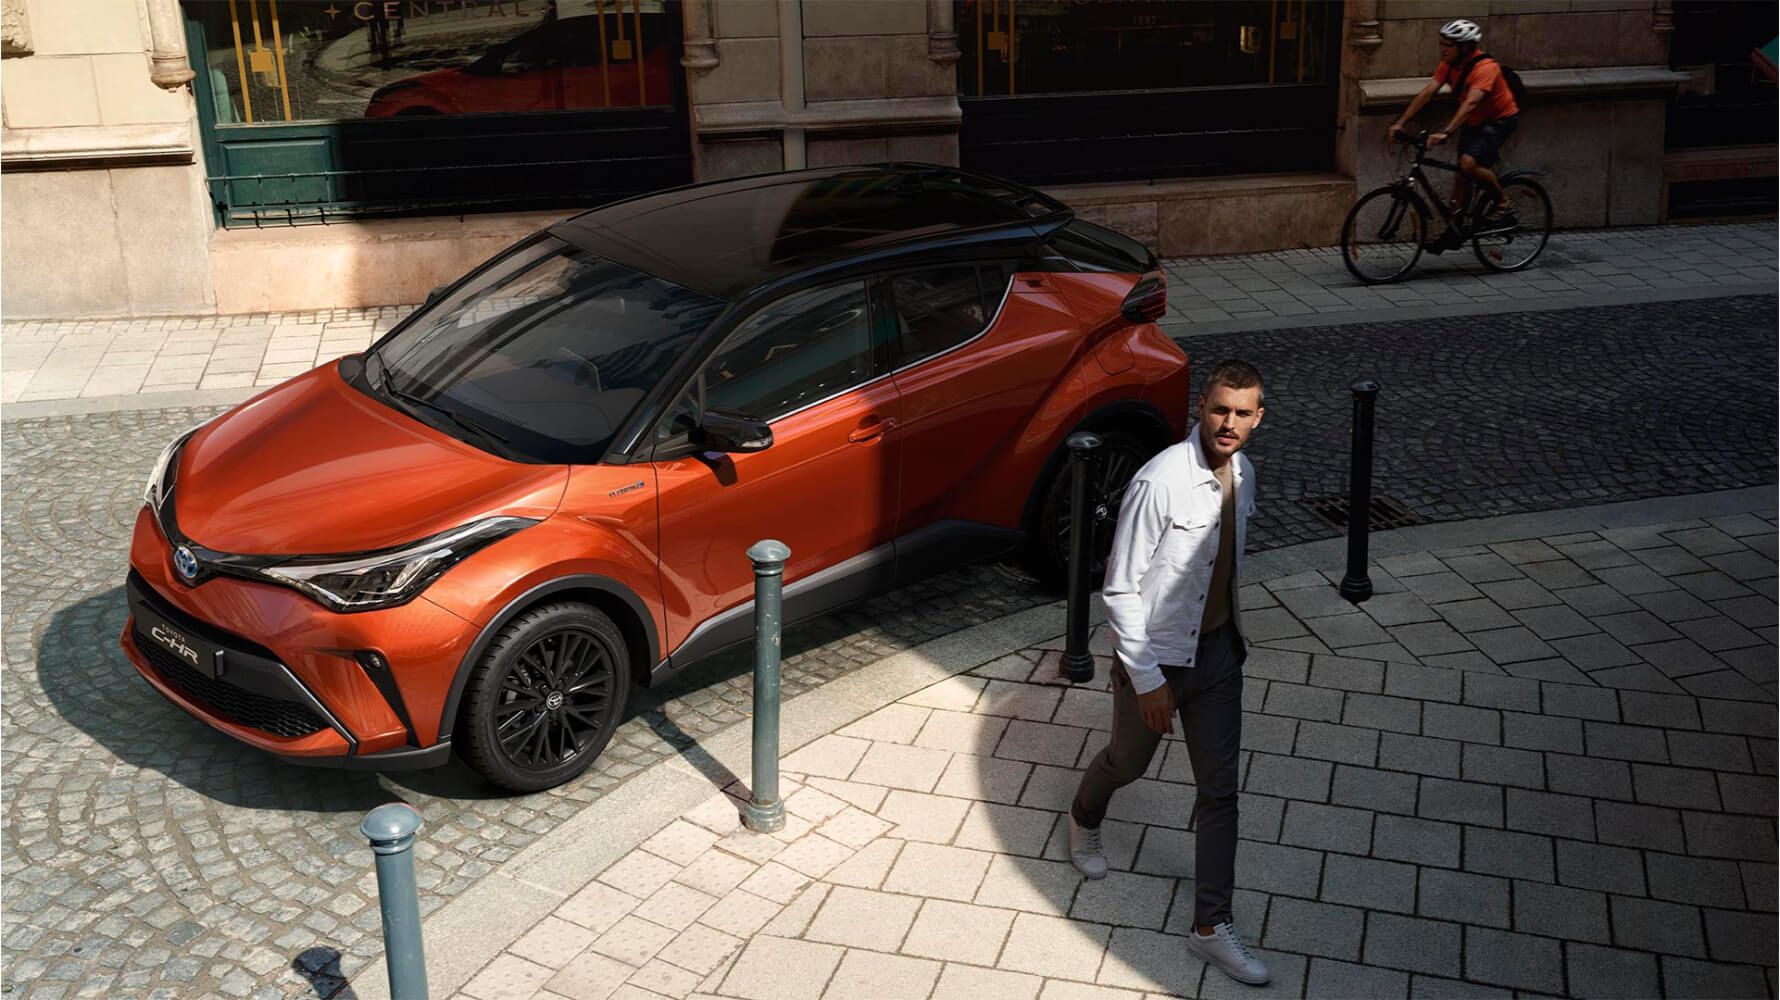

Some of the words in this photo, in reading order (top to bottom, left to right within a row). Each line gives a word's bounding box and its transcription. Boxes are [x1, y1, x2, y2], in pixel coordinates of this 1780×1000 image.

[353, 1, 530, 20] CENTRAL
[162, 624, 185, 642] TOYOTA
[151, 627, 199, 664] C-HR
